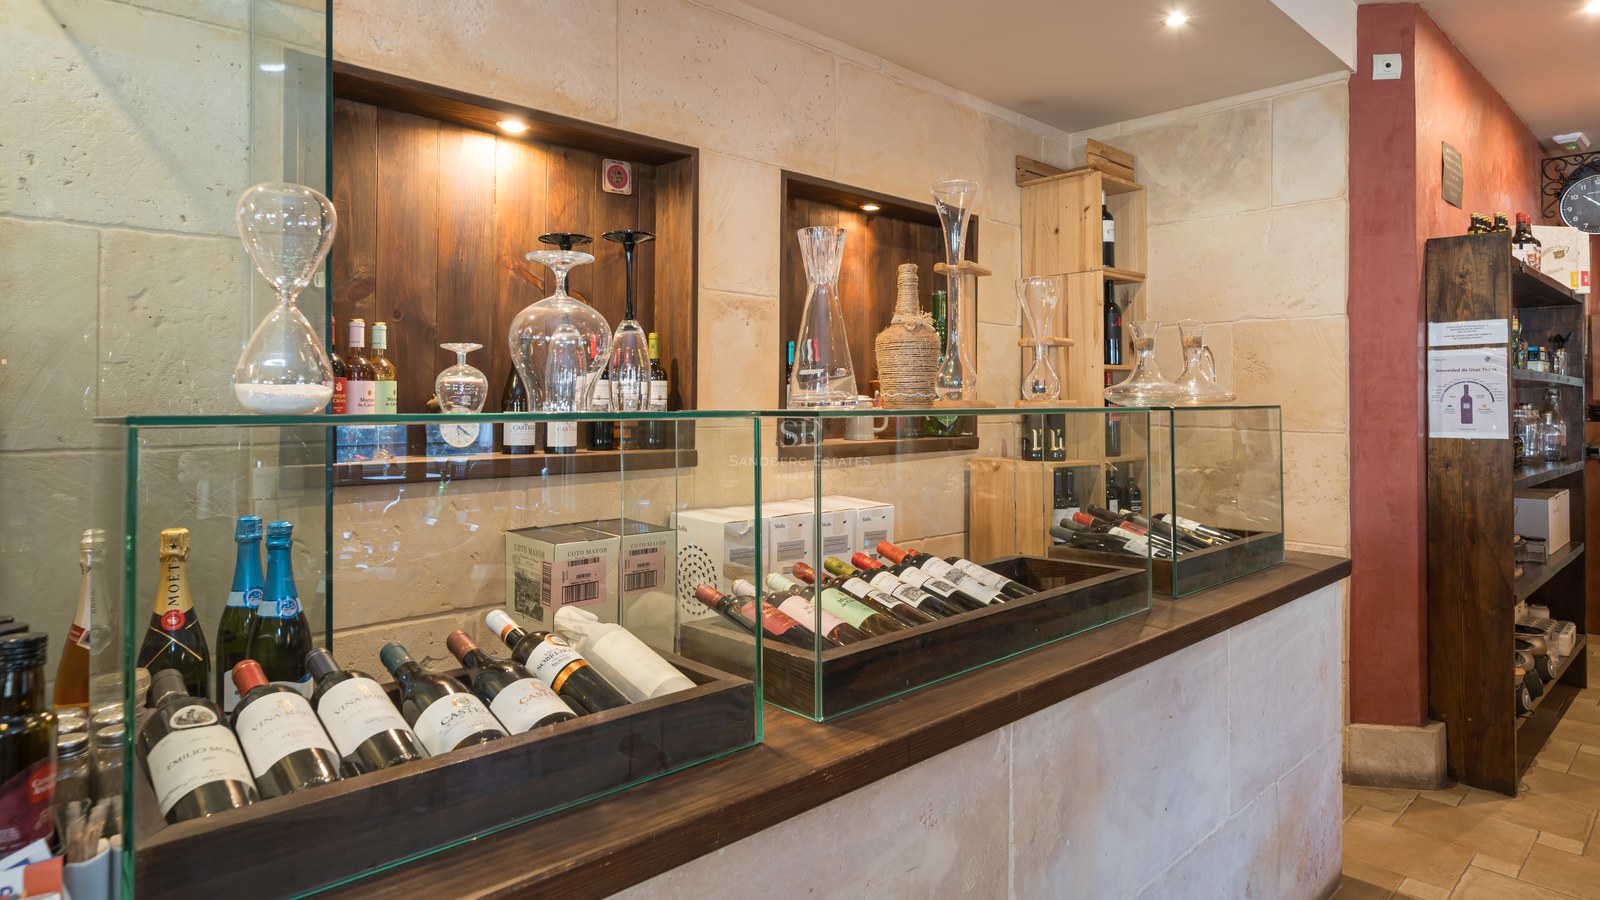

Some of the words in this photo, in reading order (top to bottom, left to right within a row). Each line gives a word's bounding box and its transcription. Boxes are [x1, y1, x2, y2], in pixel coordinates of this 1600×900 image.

[513, 543, 527, 553] COTO
[528, 547, 545, 559] MAYOR
[586, 547, 608, 555] MAYOR
[167, 564, 180, 606] MOËT
[166, 747, 207, 771] EMILIO
